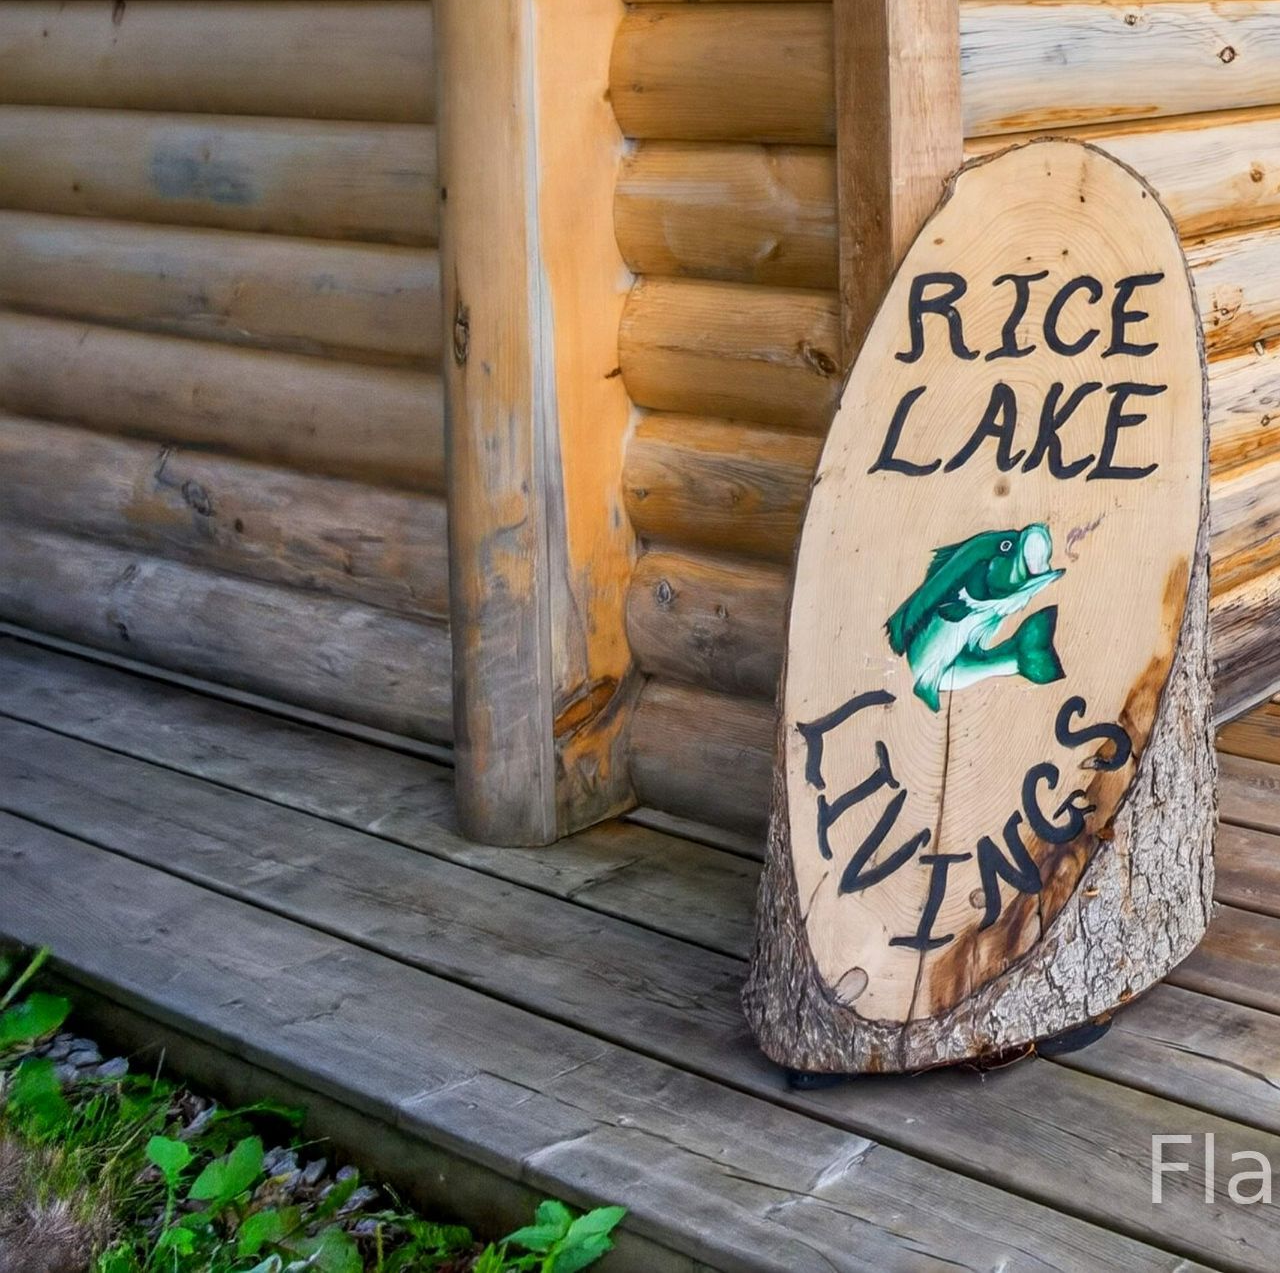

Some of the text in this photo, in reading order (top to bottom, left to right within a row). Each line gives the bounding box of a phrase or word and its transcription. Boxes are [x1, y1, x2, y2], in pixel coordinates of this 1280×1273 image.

[894, 271, 1166, 364] RICE
[868, 381, 1169, 481] LAKE
[796, 689, 1132, 952] LIVINGS
